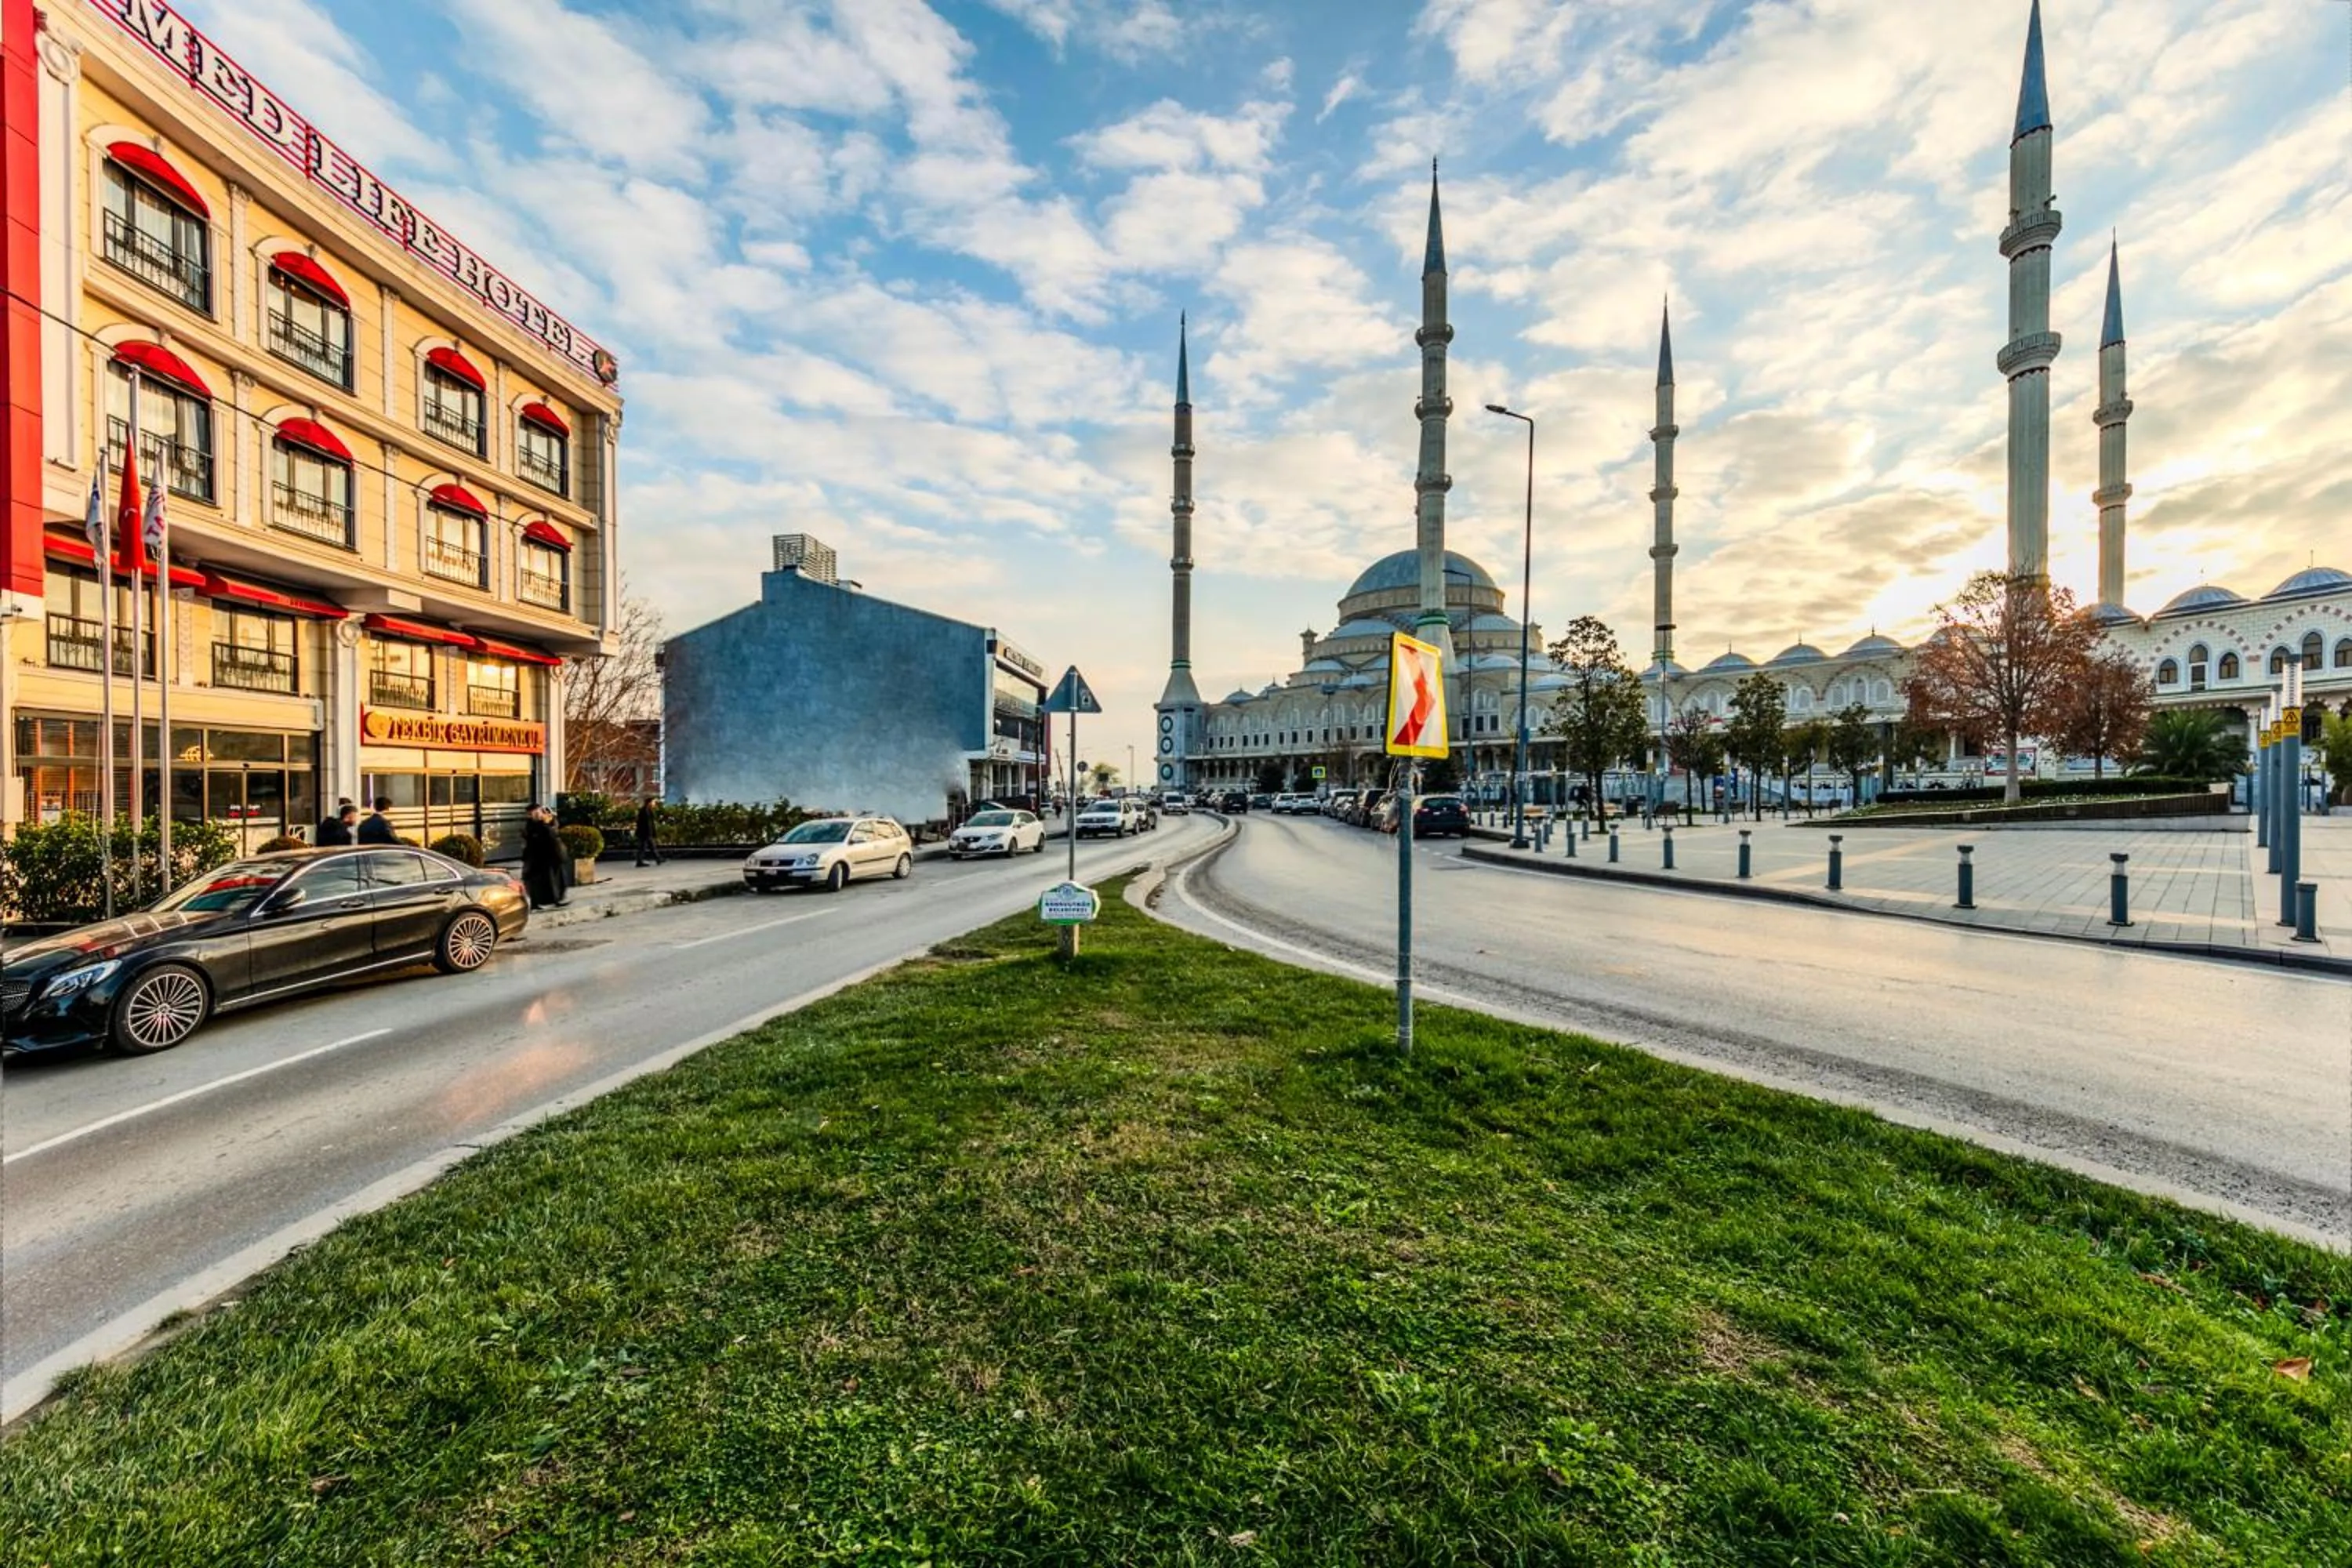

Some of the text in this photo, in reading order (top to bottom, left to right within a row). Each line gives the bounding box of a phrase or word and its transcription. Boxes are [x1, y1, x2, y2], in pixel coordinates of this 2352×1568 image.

[121, 0, 593, 368] MED LIFE HOTEL
[388, 715, 448, 744] TEKBİR
